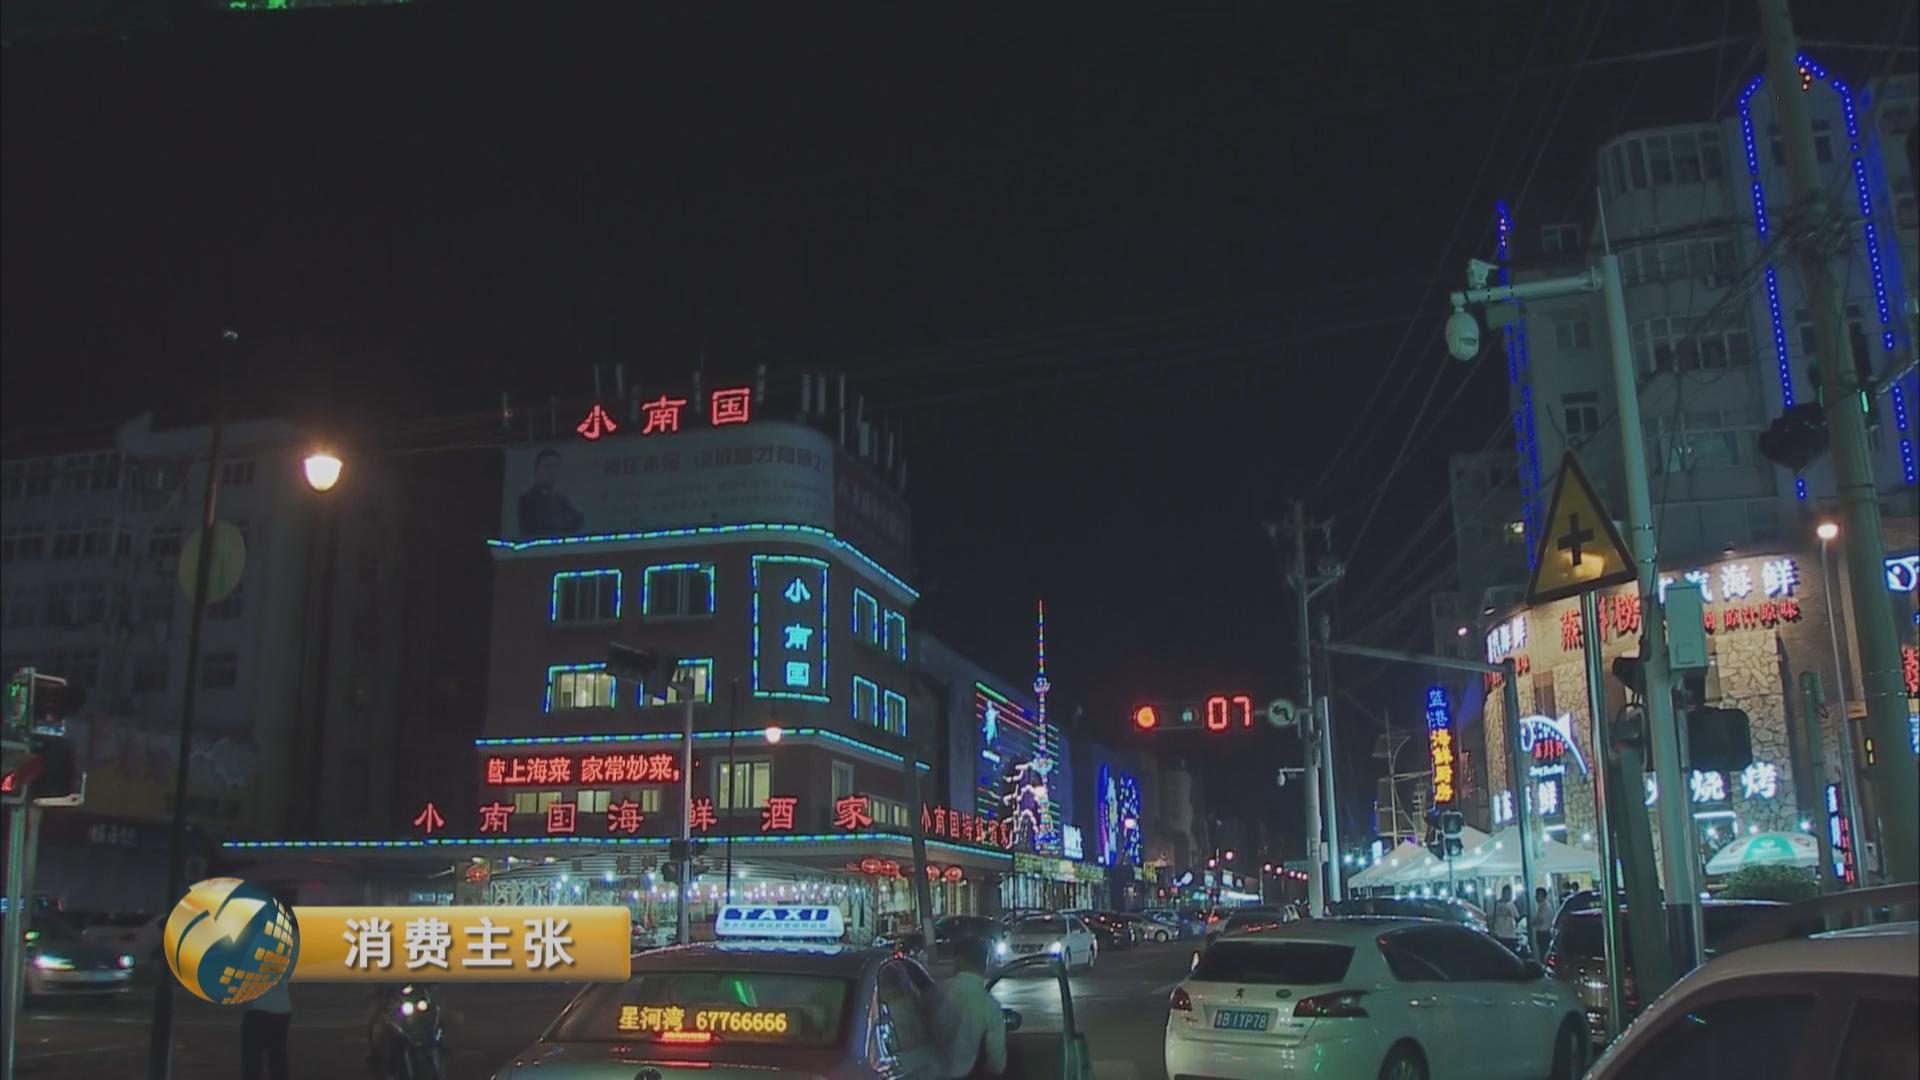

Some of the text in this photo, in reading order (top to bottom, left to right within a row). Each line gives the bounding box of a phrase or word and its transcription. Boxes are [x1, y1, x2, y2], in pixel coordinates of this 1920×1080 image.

[577, 387, 750, 440] 小南国
[784, 577, 813, 686] 小南国
[1205, 694, 1254, 731] 07
[414, 797, 873, 834] 小南国海鲜酒家
[737, 908, 818, 920] TAXI
[618, 1005, 788, 1033] 星河湾 67766666
